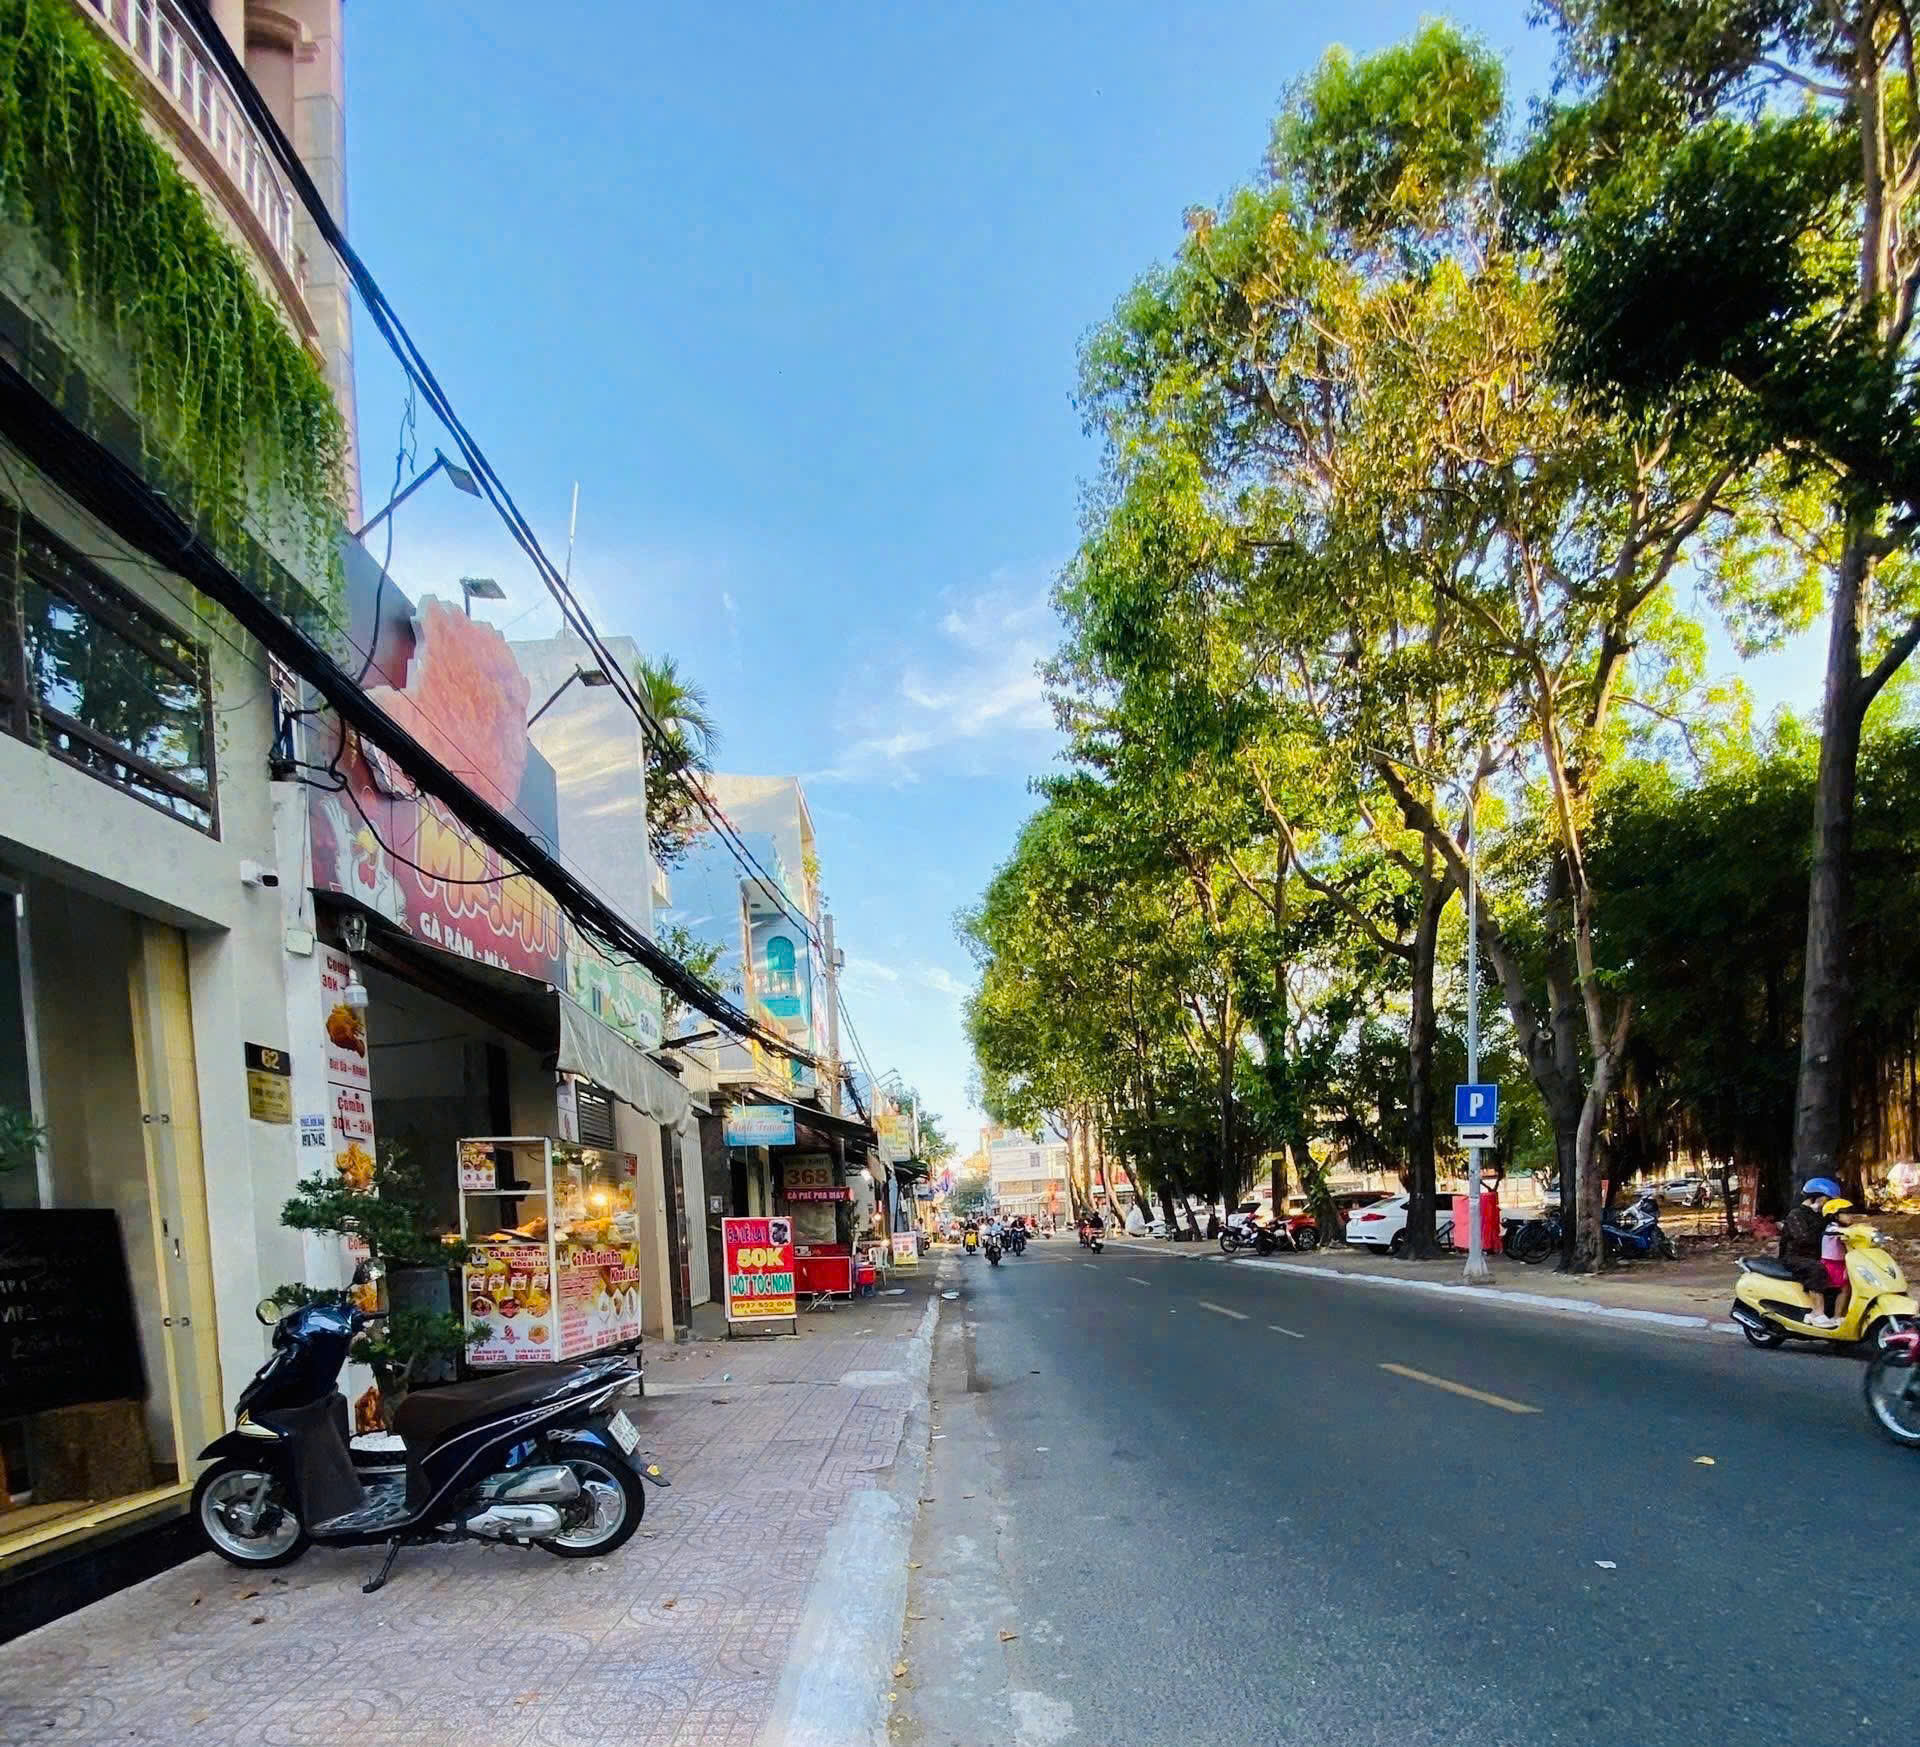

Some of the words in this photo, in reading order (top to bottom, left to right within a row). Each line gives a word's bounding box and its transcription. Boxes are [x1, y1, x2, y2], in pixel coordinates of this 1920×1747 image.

[420, 912, 442, 944] GÀ
[444, 924, 474, 960] RÁN
[322, 974, 338, 992] 30K
[261, 1049, 280, 1071] 62
[1469, 1092, 1484, 1118] P
[788, 1168, 829, 1185] 368
[737, 1248, 785, 1268] 50K
